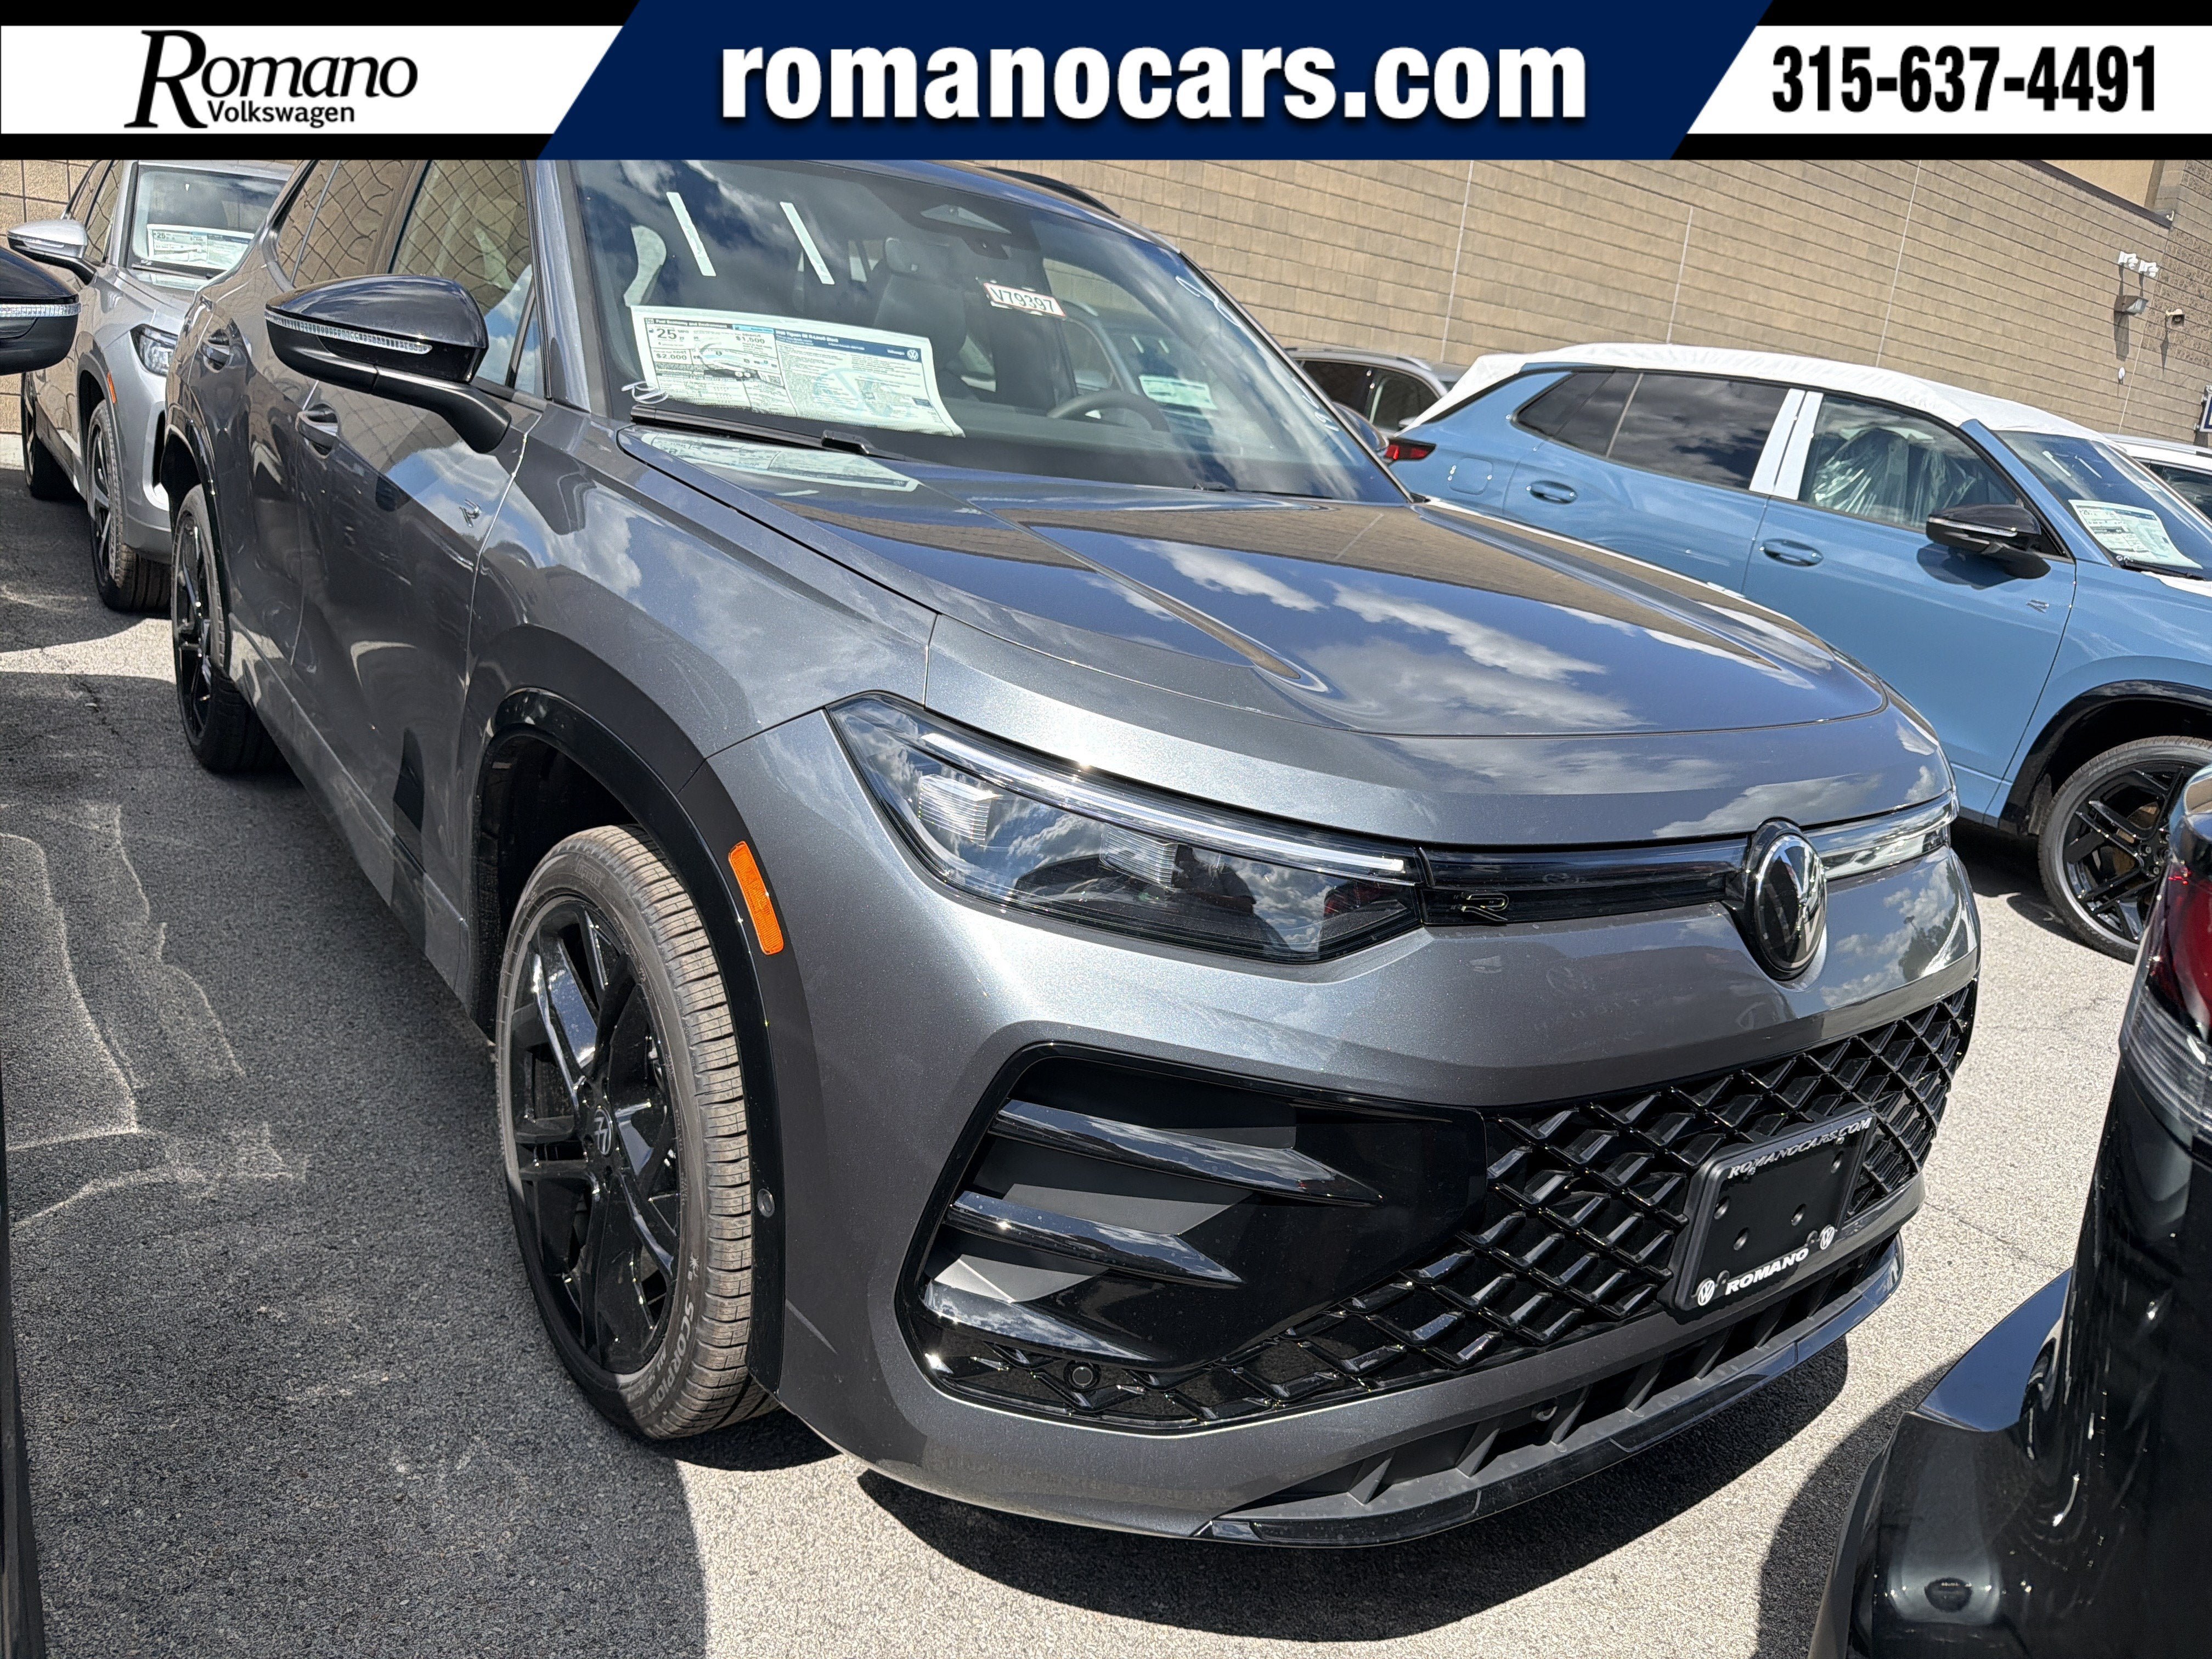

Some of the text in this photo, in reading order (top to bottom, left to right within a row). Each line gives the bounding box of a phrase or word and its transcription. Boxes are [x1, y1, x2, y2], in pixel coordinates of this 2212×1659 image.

[989, 286, 1054, 313] V79397
[657, 328, 677, 340] 25
[1725, 1248, 1809, 1295] ROMANO
[648, 1293, 695, 1412] SCORPION
